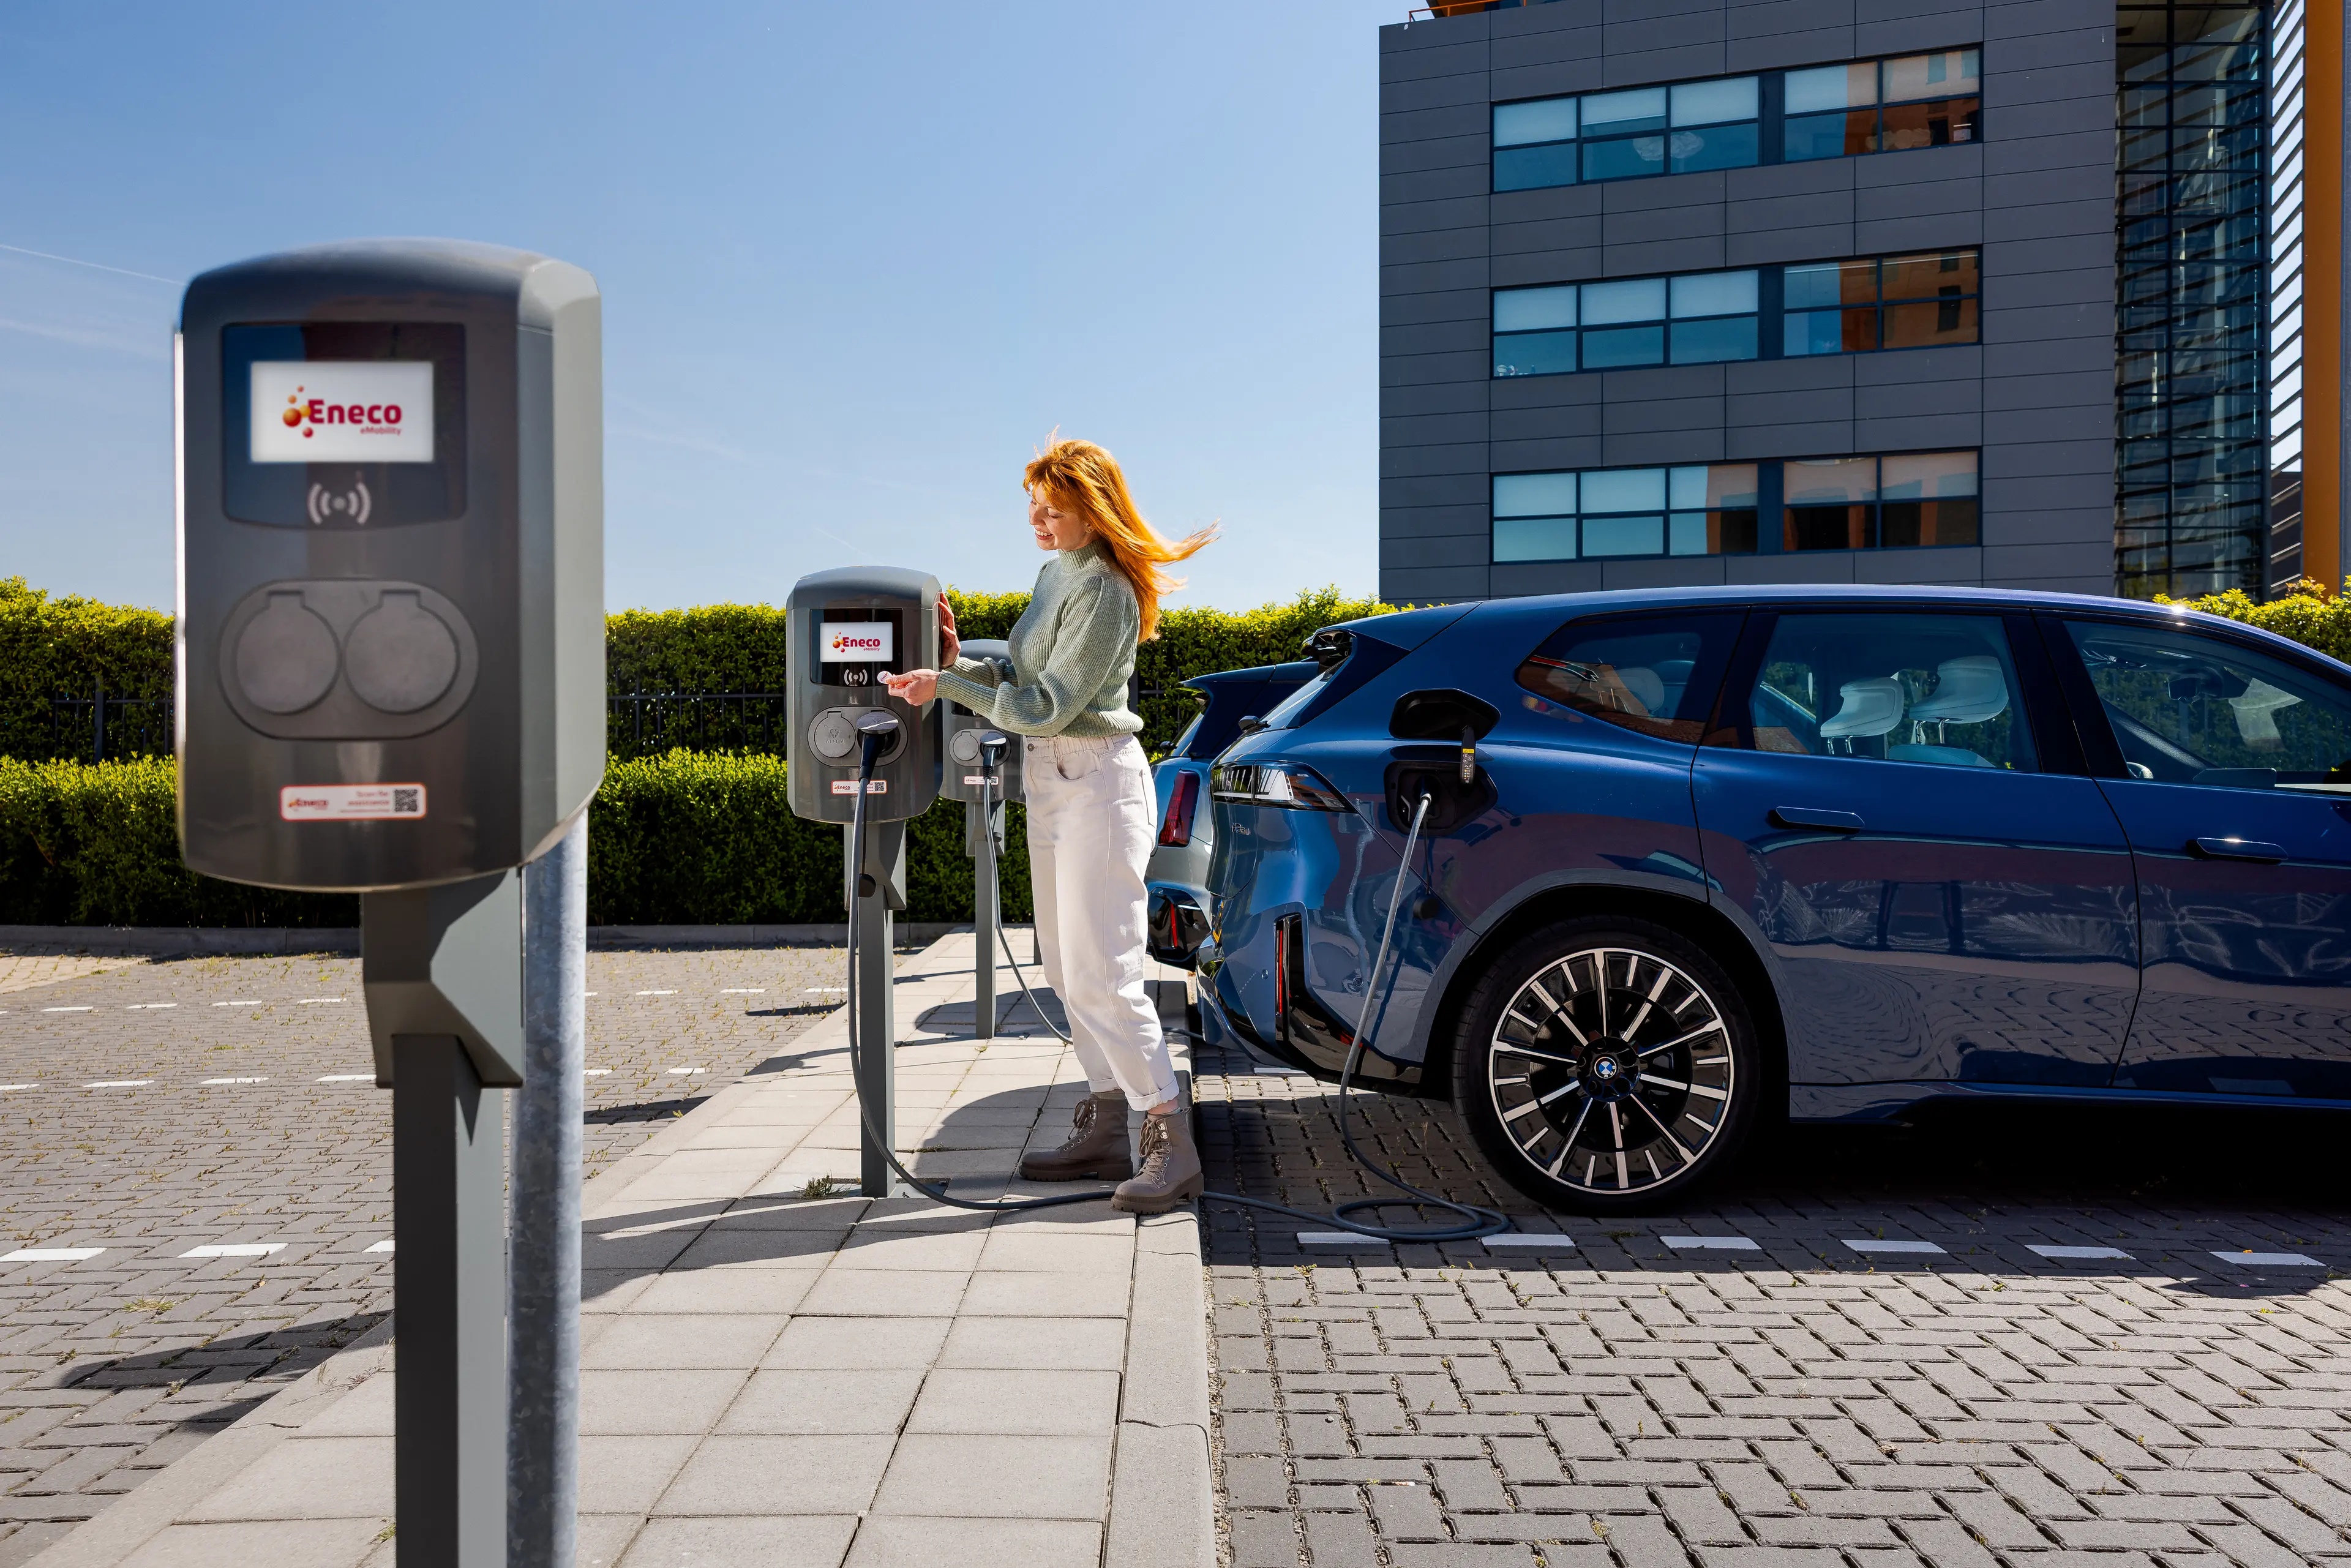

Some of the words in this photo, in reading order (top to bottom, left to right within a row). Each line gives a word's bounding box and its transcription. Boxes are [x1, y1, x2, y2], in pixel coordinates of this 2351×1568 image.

[307, 399, 402, 424] Eneco
[359, 427, 402, 435] eMobility
[842, 637, 880, 647] Eneco
